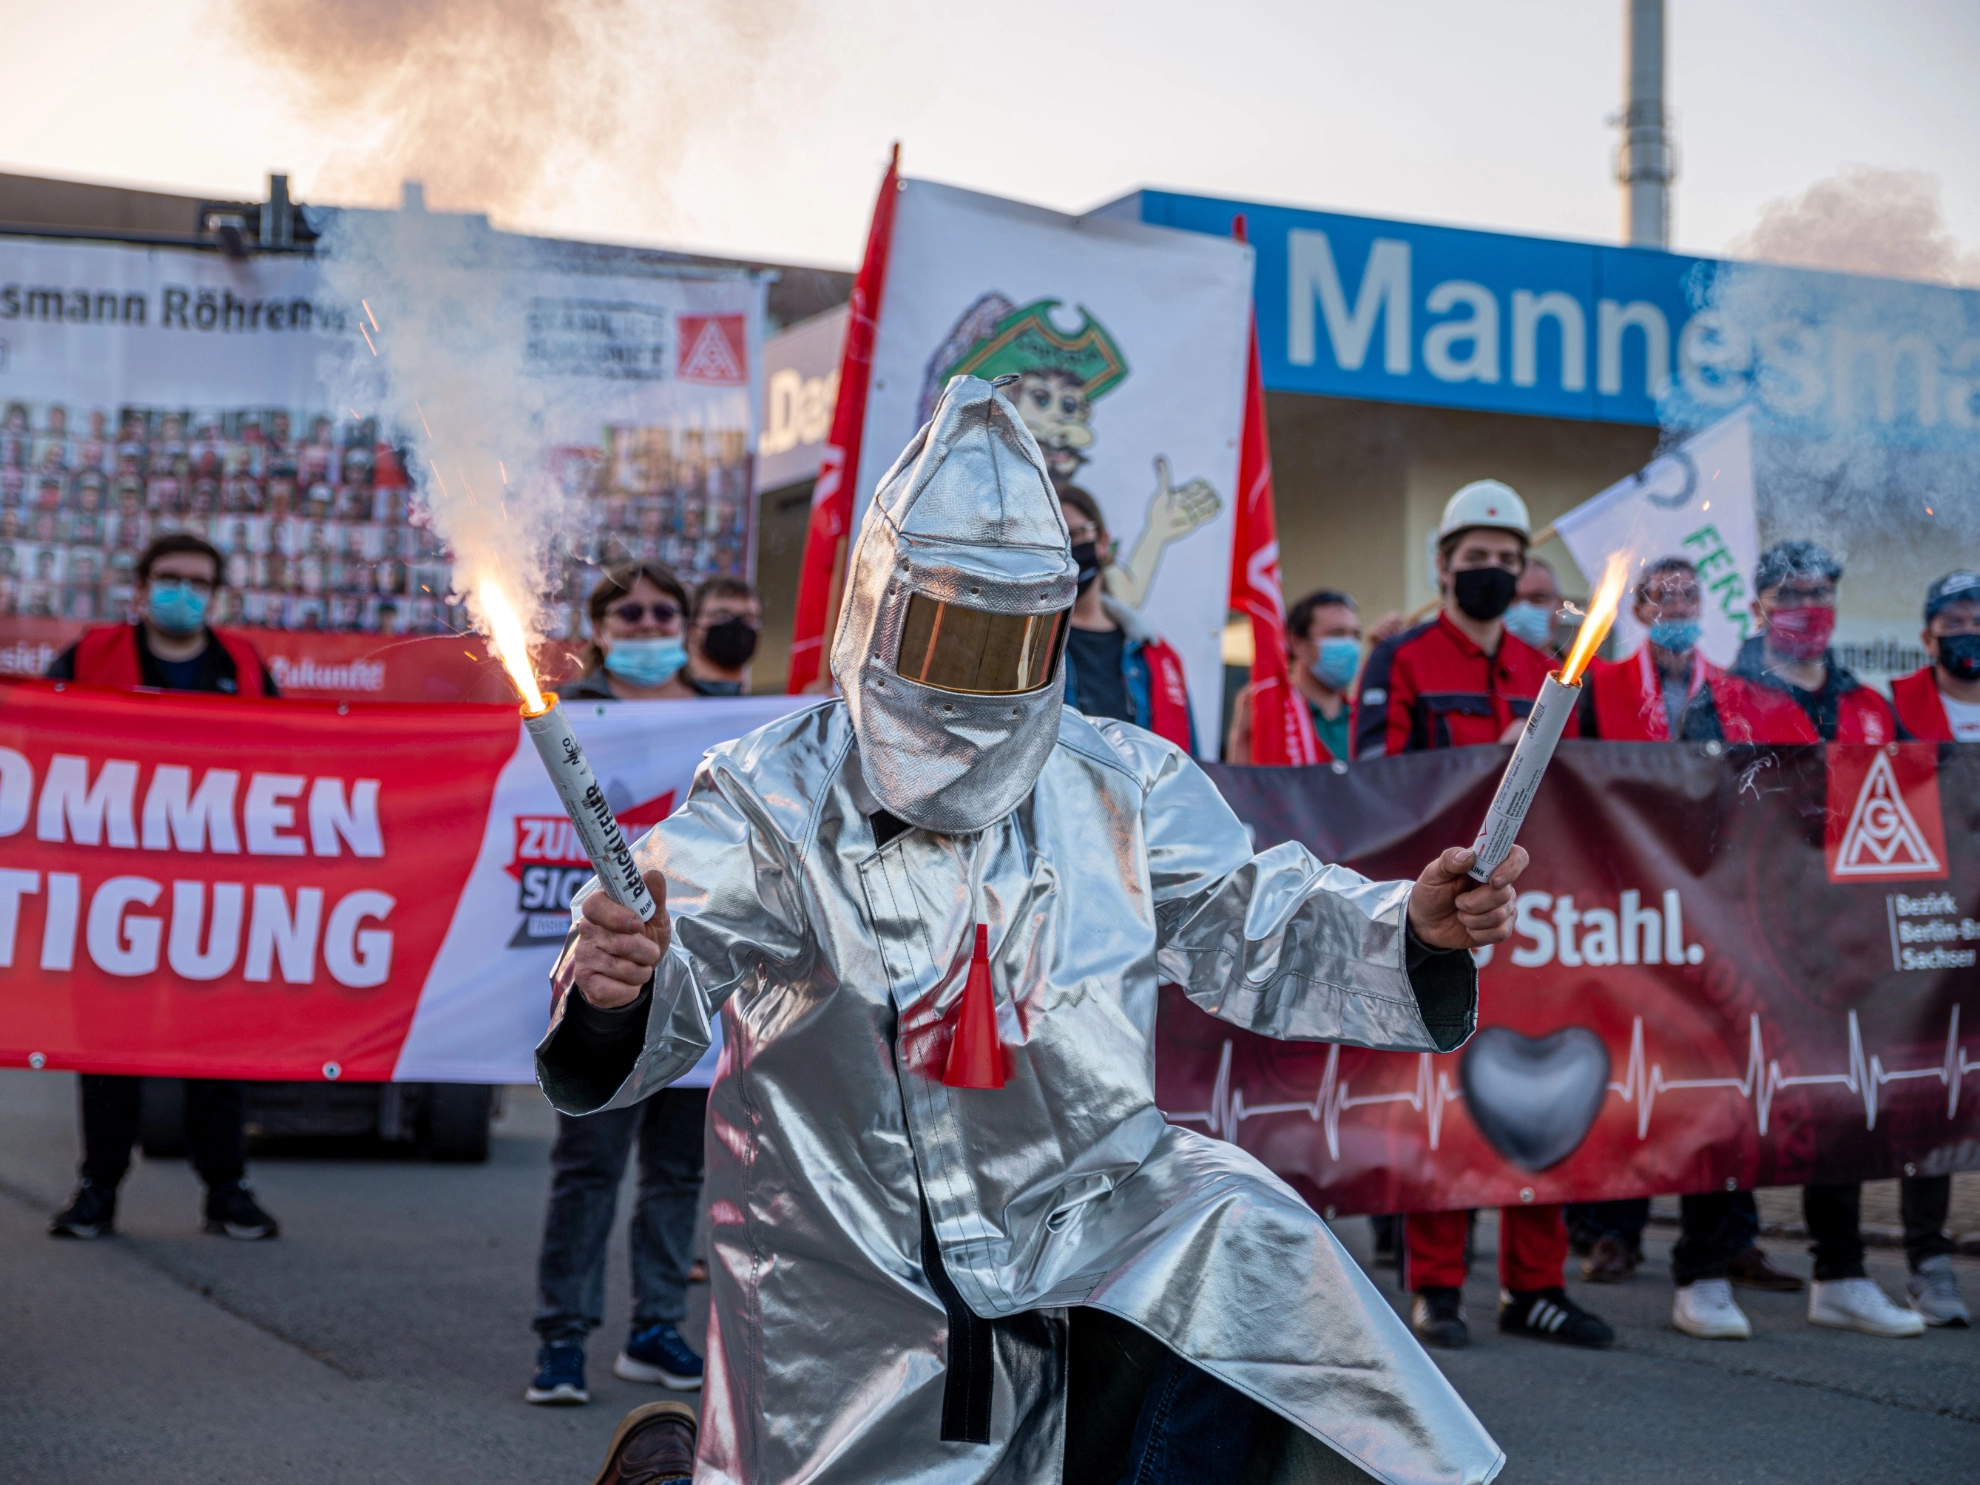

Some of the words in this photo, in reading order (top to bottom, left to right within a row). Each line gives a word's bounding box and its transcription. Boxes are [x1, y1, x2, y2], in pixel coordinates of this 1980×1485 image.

[561, 736, 581, 766] NICO
[1895, 891, 1958, 916] Bezirk
[1511, 888, 1705, 967] Stahl.
